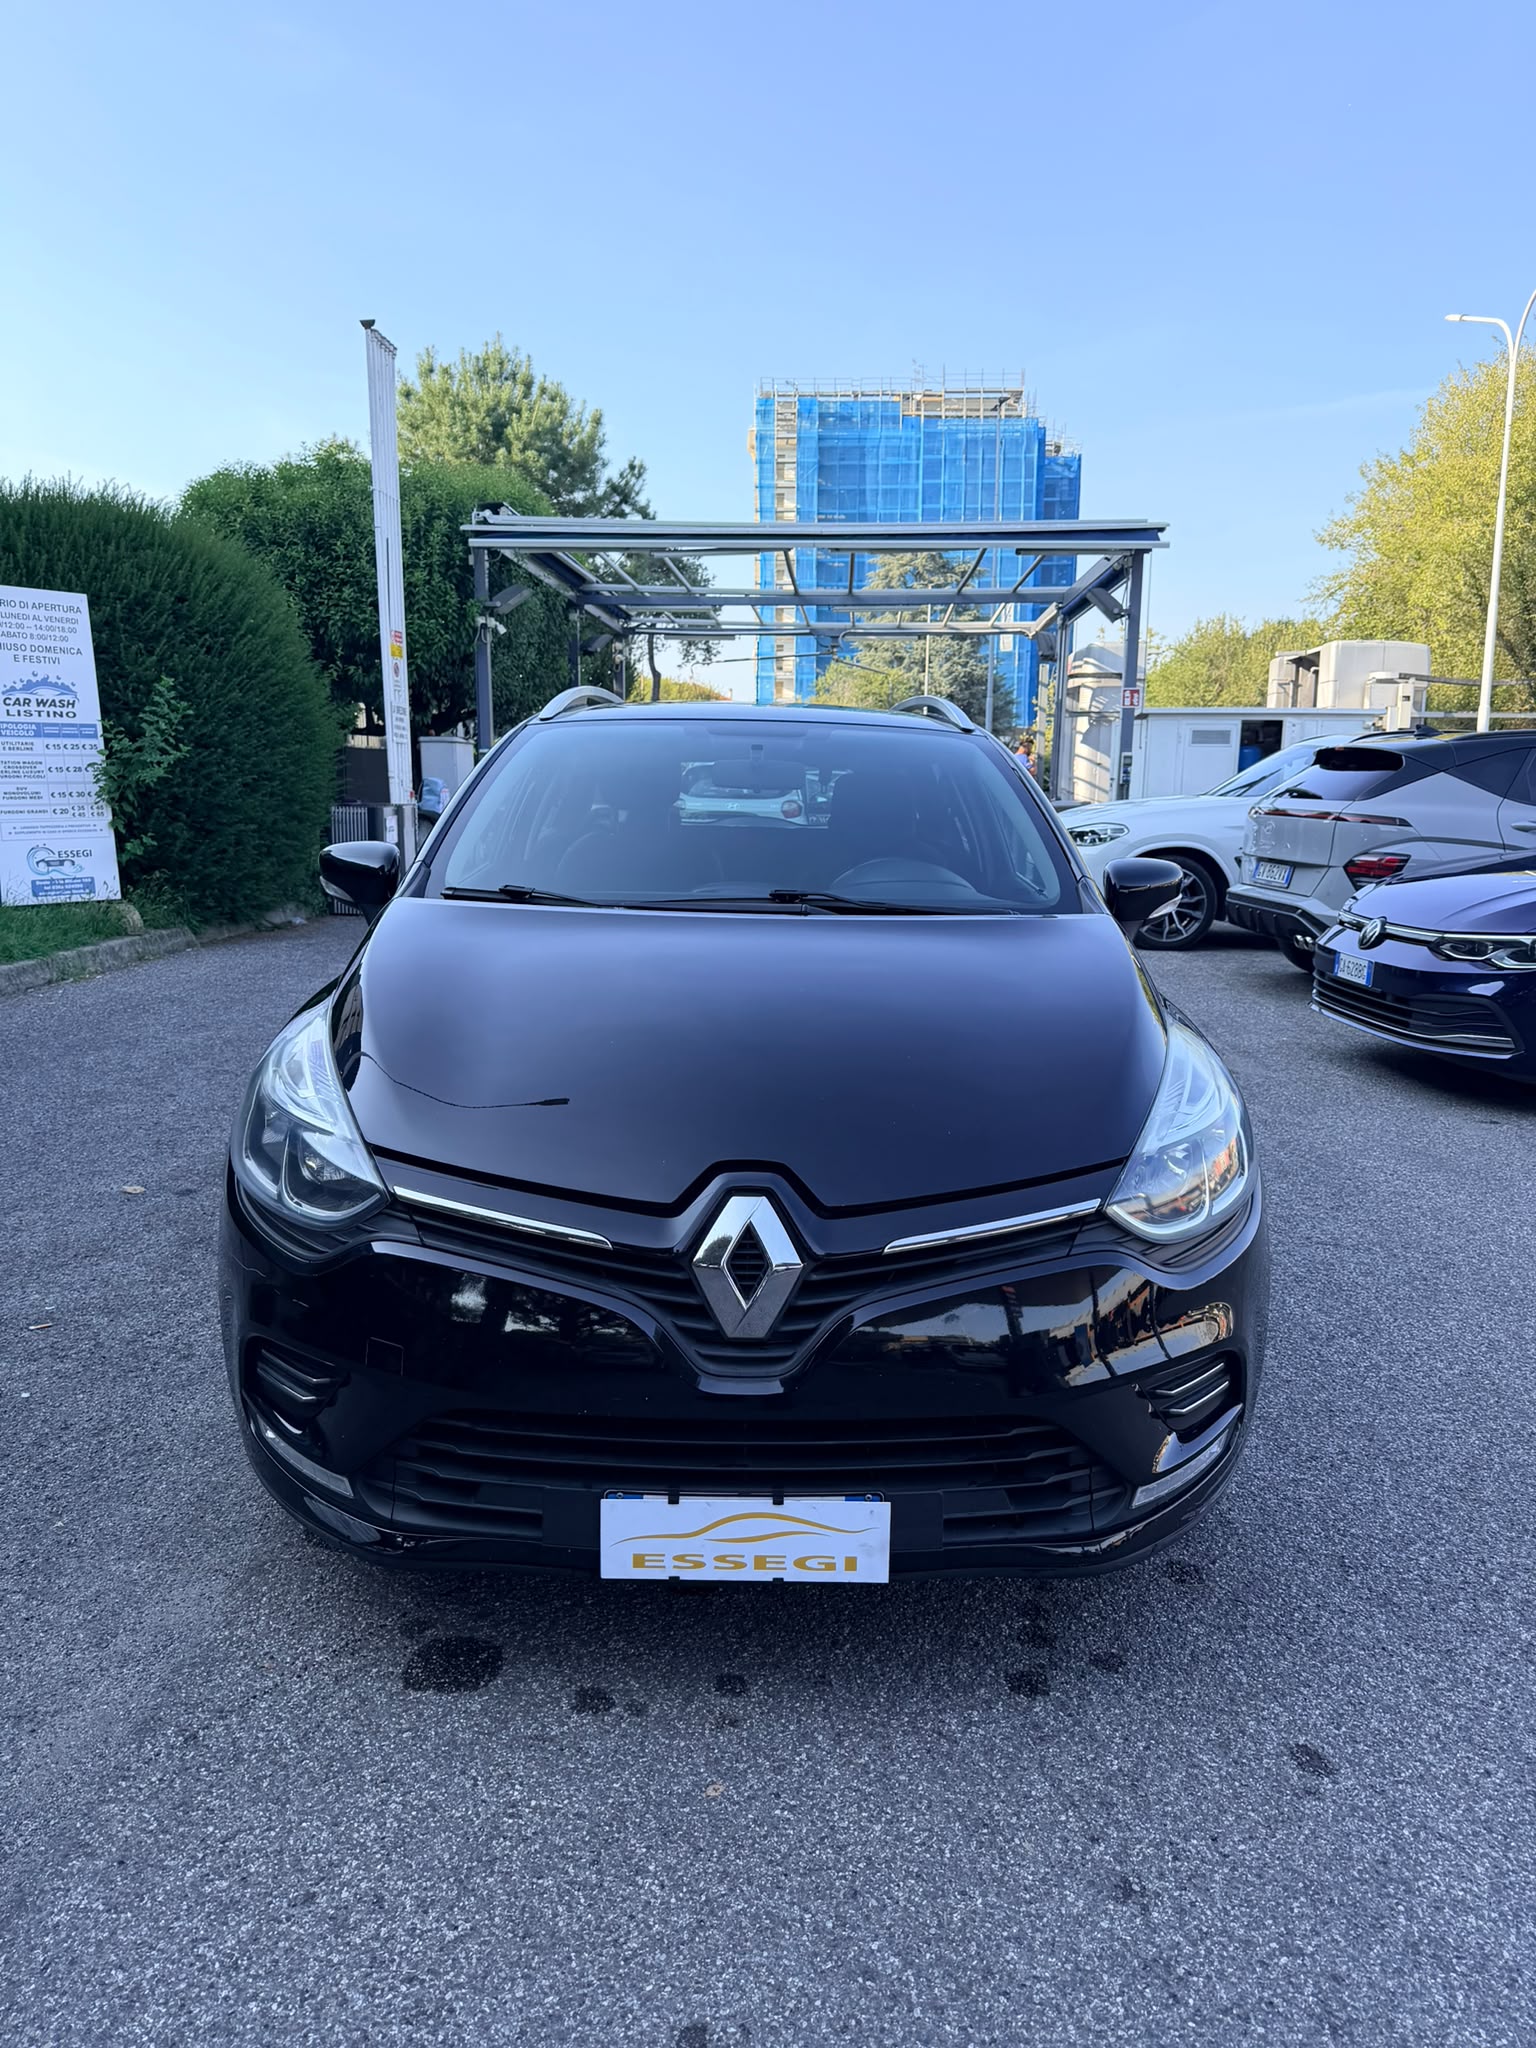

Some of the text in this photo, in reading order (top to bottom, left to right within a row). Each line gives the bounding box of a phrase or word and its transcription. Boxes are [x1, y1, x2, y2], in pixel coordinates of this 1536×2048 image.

[19, 601, 29, 609] DI
[31, 602, 82, 614] APERTURA
[0, 612, 79, 625] LUNEDI AL VENERDI
[30, 645, 83, 656] DOMENICA
[13, 654, 60, 665] E FESTIVI
[3, 697, 76, 709] CAR WASH
[6, 709, 77, 719] LISTINO
[57, 849, 92, 858] ESSEGI
[632, 1553, 857, 1572] ESSEGI
